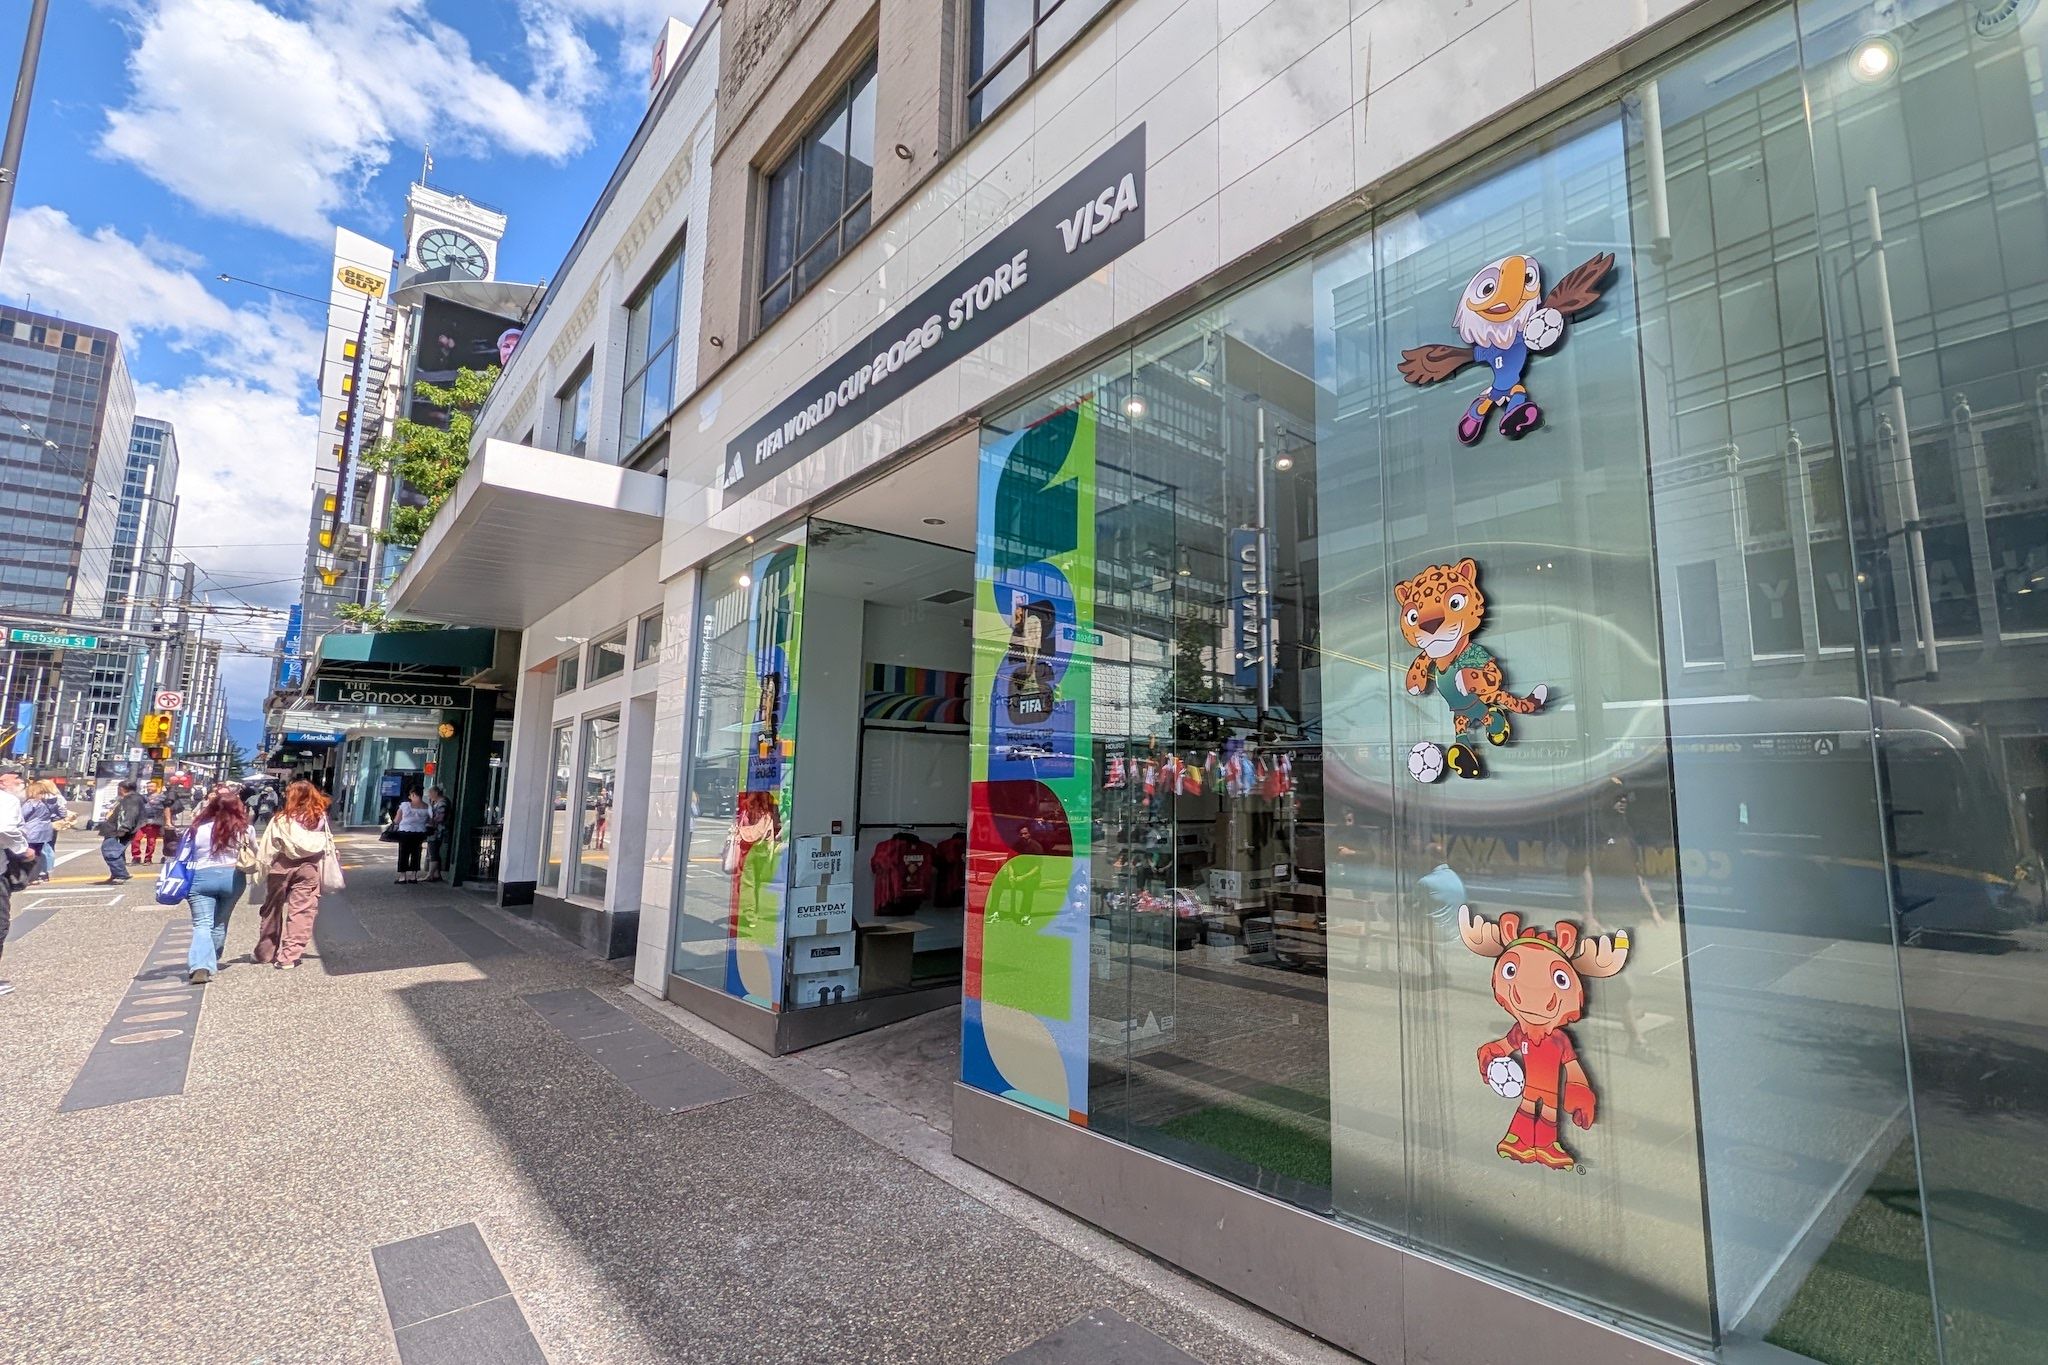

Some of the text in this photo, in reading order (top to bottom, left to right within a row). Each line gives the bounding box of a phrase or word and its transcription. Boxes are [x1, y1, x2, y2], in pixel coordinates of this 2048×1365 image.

[1056, 173, 1138, 254] VISA
[345, 269, 384, 287] BEST
[345, 277, 378, 292] BUY
[755, 249, 1029, 465] FIFA WORLD CUP 2026 STORE
[22, 633, 87, 646] Robson St
[345, 681, 371, 691] THE
[338, 689, 454, 706] Lennox PUB
[1020, 699, 1042, 714] FIFA
[300, 733, 336, 742] Marshalls
[811, 859, 830, 870] Tee
[797, 903, 846, 914] EVERYDAY
[797, 910, 846, 919] COLLECTION
